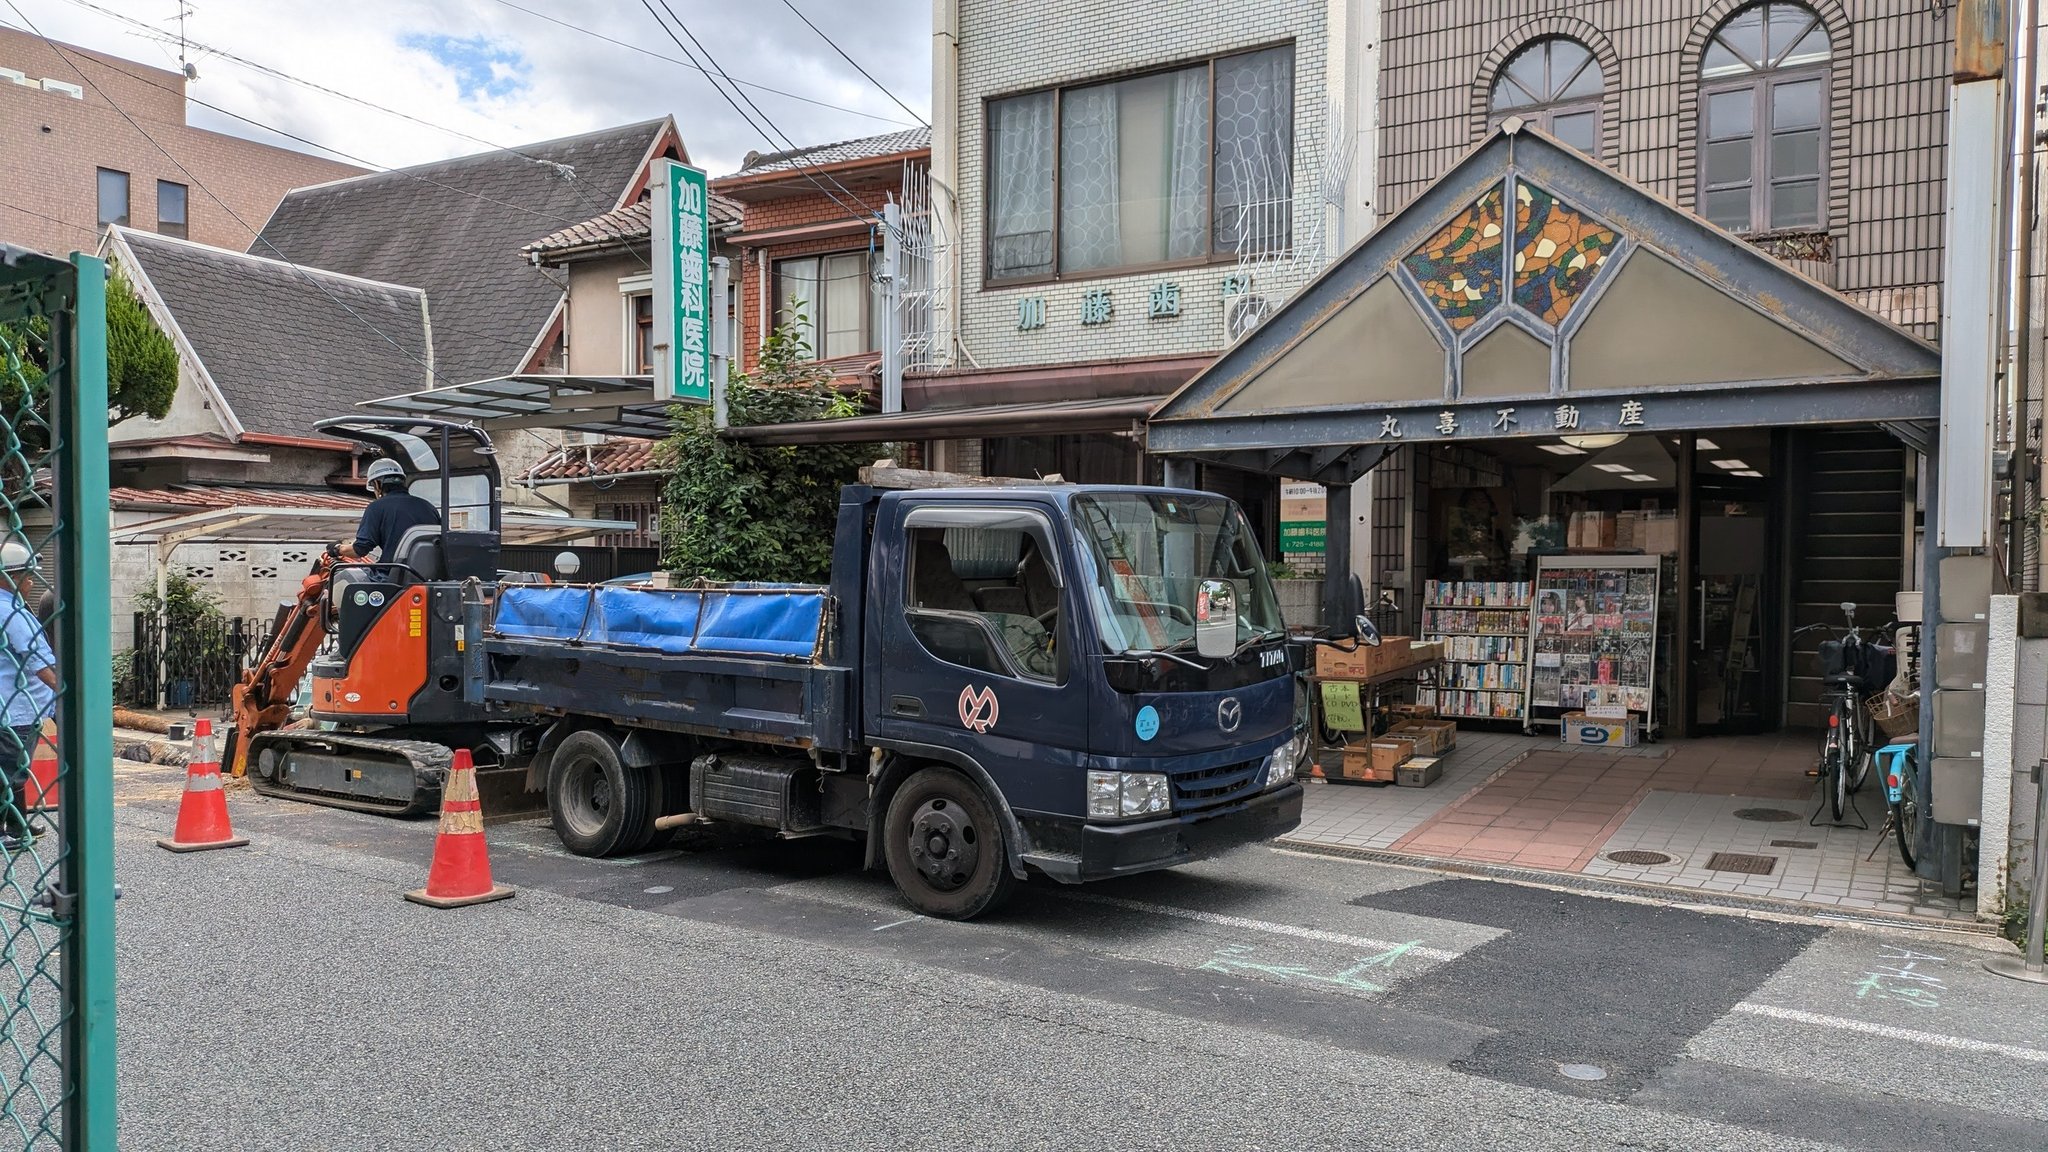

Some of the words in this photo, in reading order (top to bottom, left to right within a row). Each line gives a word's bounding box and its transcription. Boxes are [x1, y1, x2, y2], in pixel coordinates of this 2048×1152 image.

[678, 176, 705, 388] 加藤歯科医院
[1378, 400, 1645, 438] 丸喜不動産
